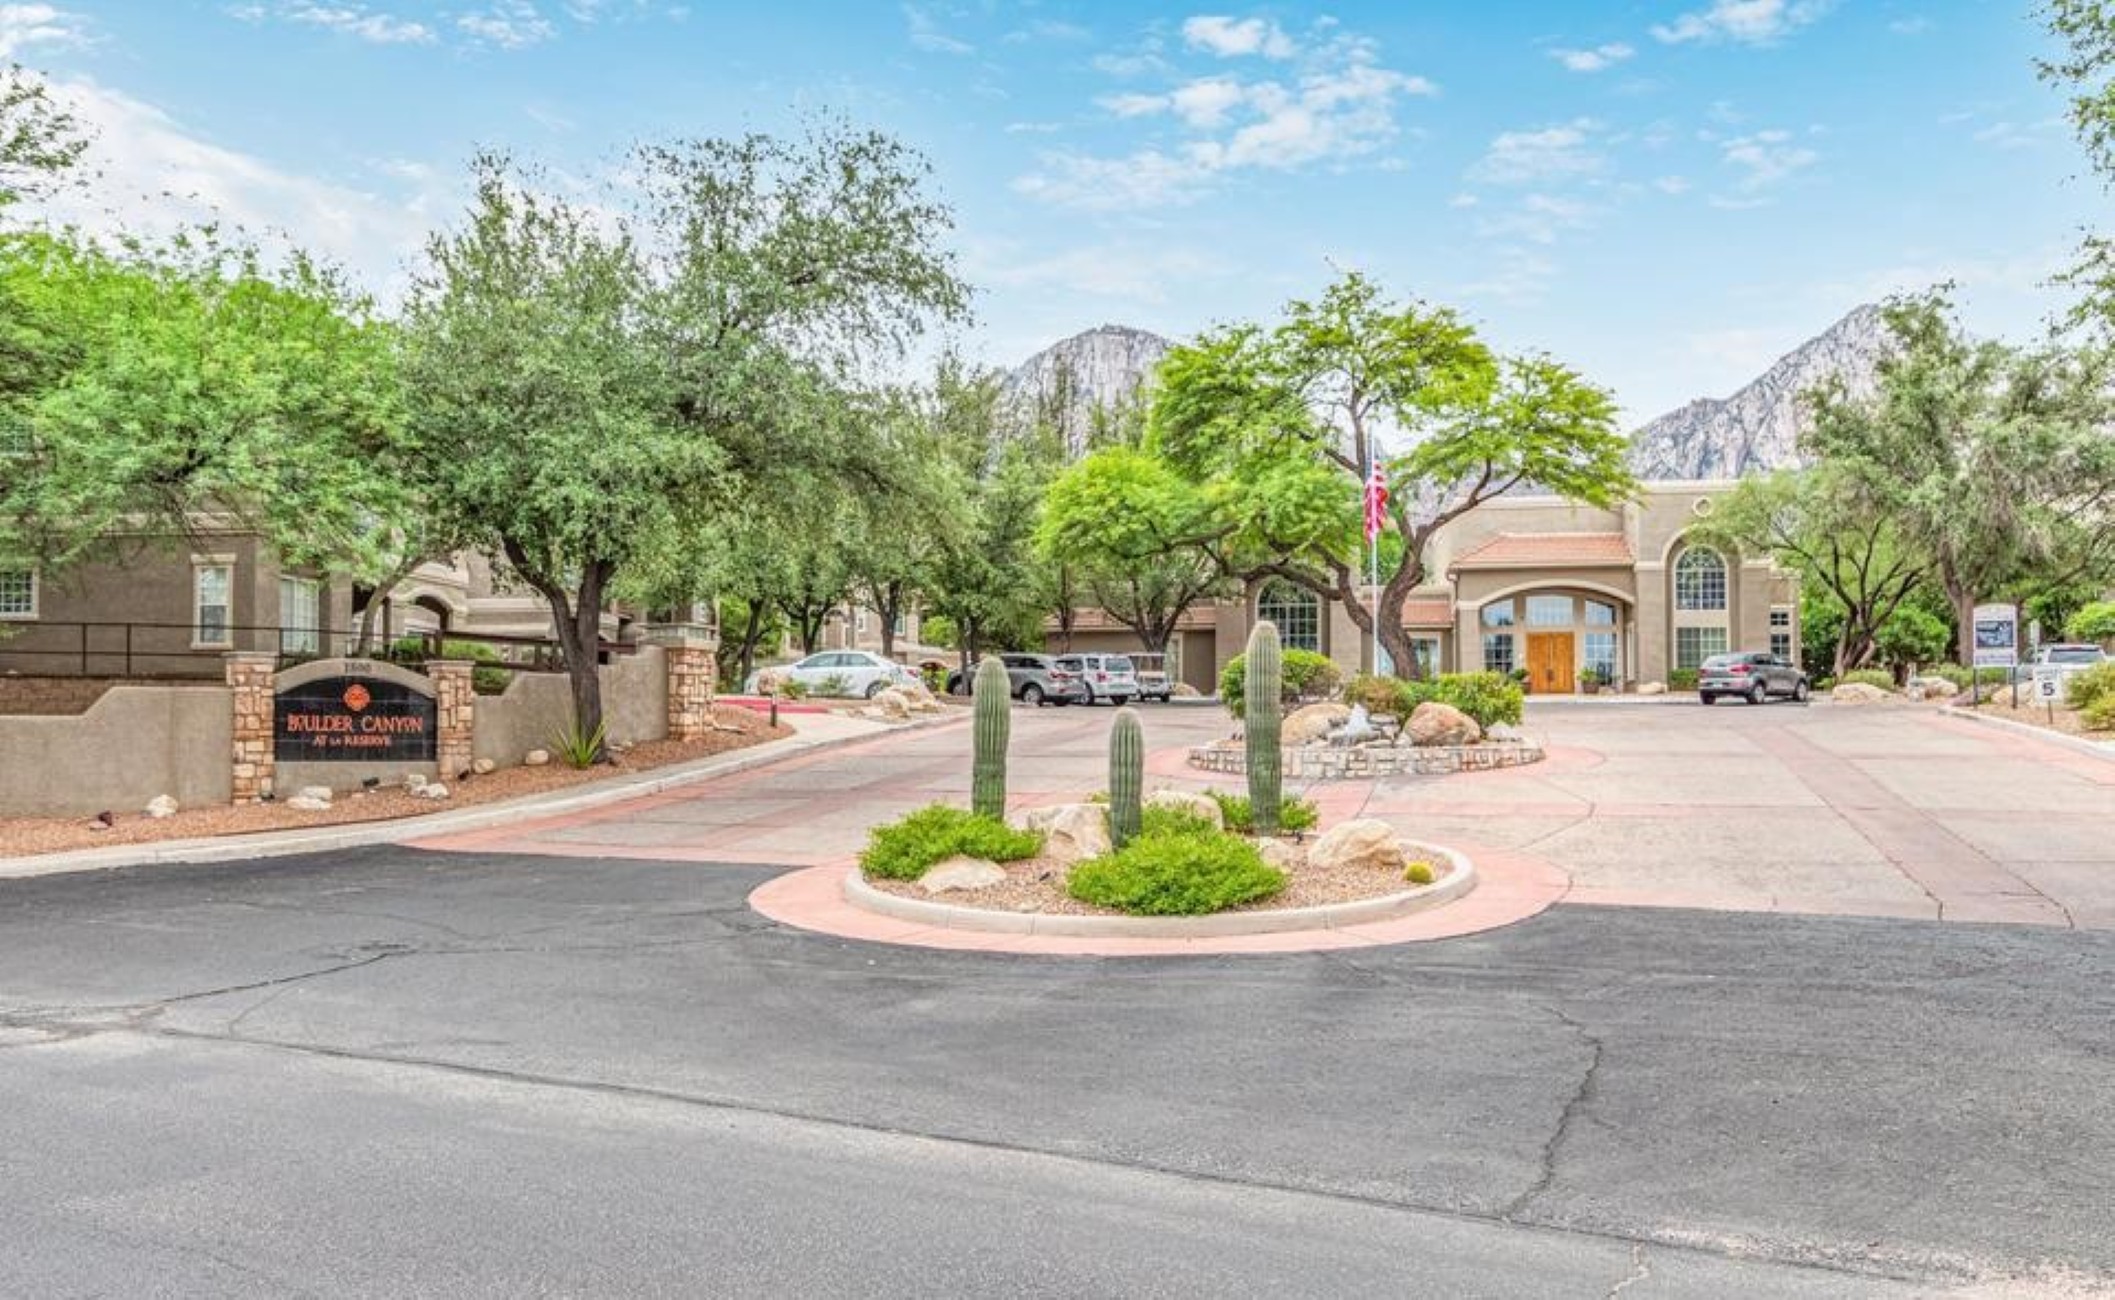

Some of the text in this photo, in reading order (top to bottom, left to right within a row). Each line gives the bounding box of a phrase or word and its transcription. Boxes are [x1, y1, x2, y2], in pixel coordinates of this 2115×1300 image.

[2042, 682, 2055, 696] 5
[287, 714, 423, 733] BOULDER CANYON
